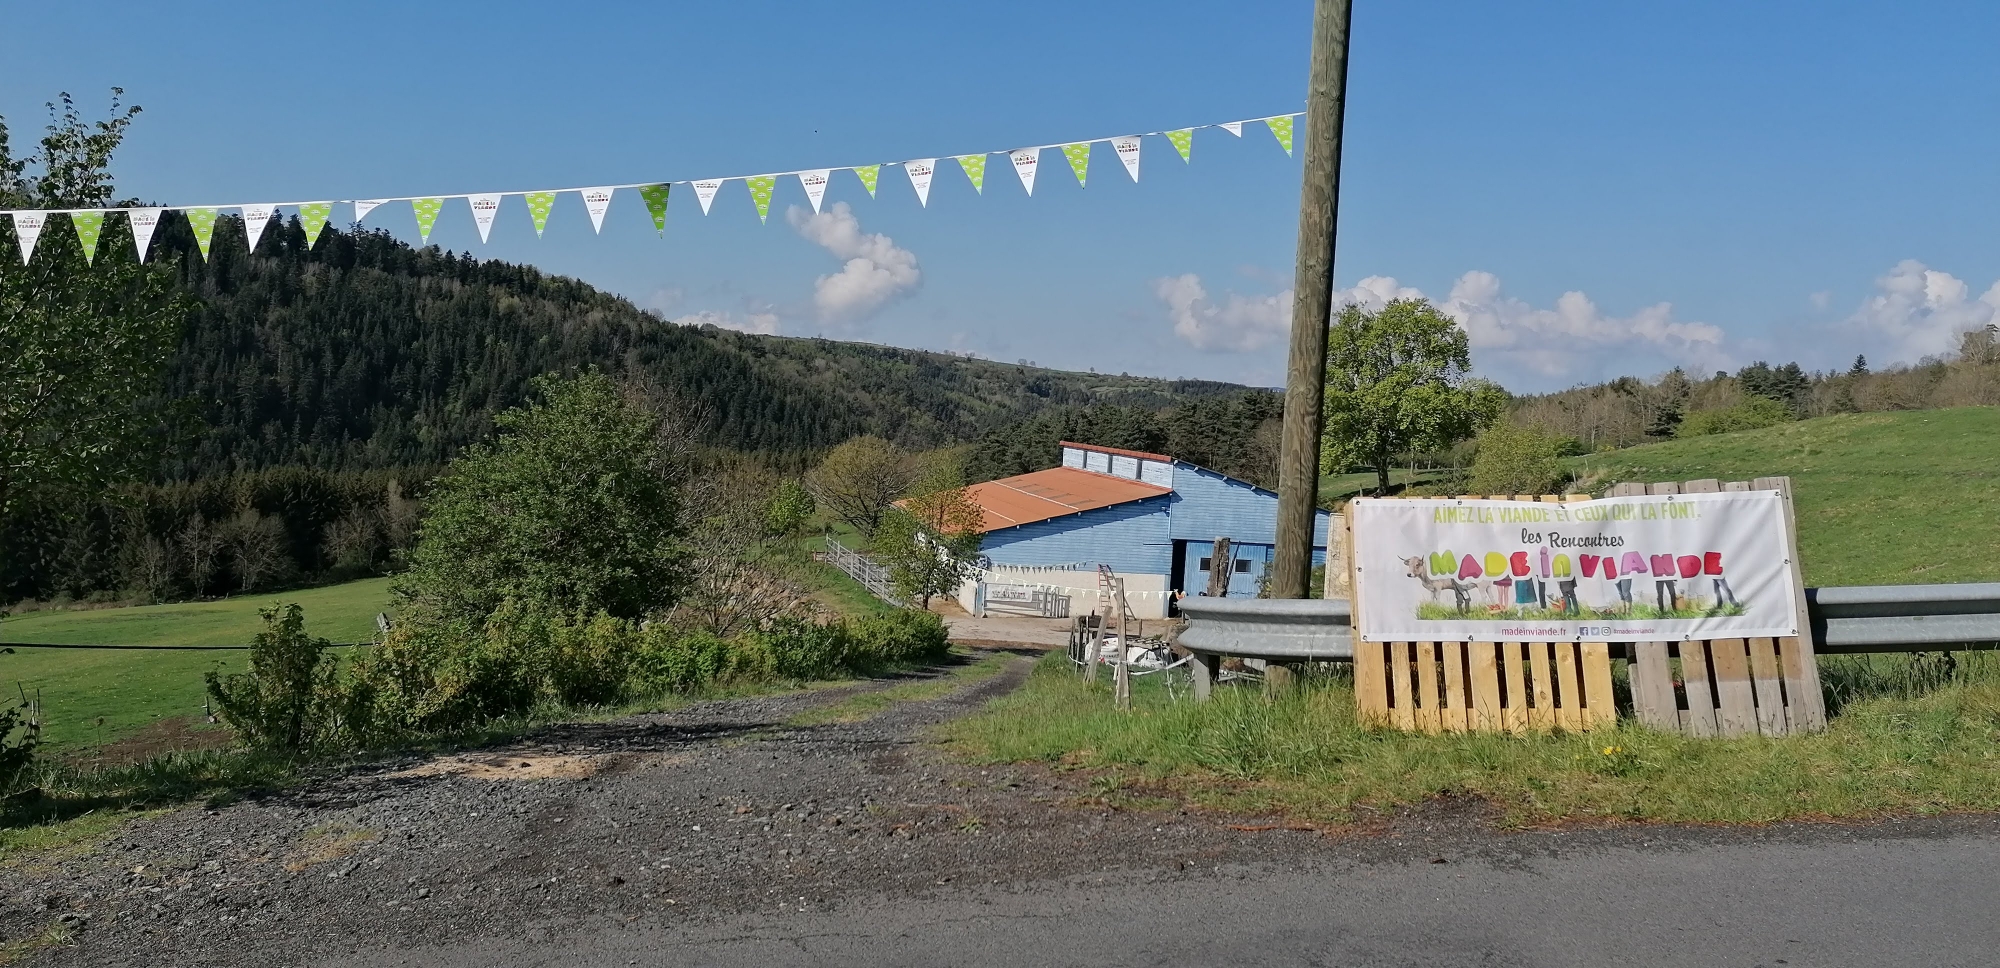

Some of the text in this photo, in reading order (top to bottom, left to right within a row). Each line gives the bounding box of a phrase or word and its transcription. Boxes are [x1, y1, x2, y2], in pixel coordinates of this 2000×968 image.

[1433, 507, 1474, 523] AIMEZ
[1477, 506, 1494, 524] LA
[1498, 507, 1551, 523] VIANDE
[1554, 509, 1571, 522] ET
[1574, 504, 1609, 522] CEUX
[1612, 503, 1636, 521] QUI
[1641, 502, 1657, 520] LA
[1521, 527, 1624, 548] les Rencontres
[1429, 545, 1723, 581] MADE in VIANDE
[1501, 627, 1566, 636] madeinviande.fr
